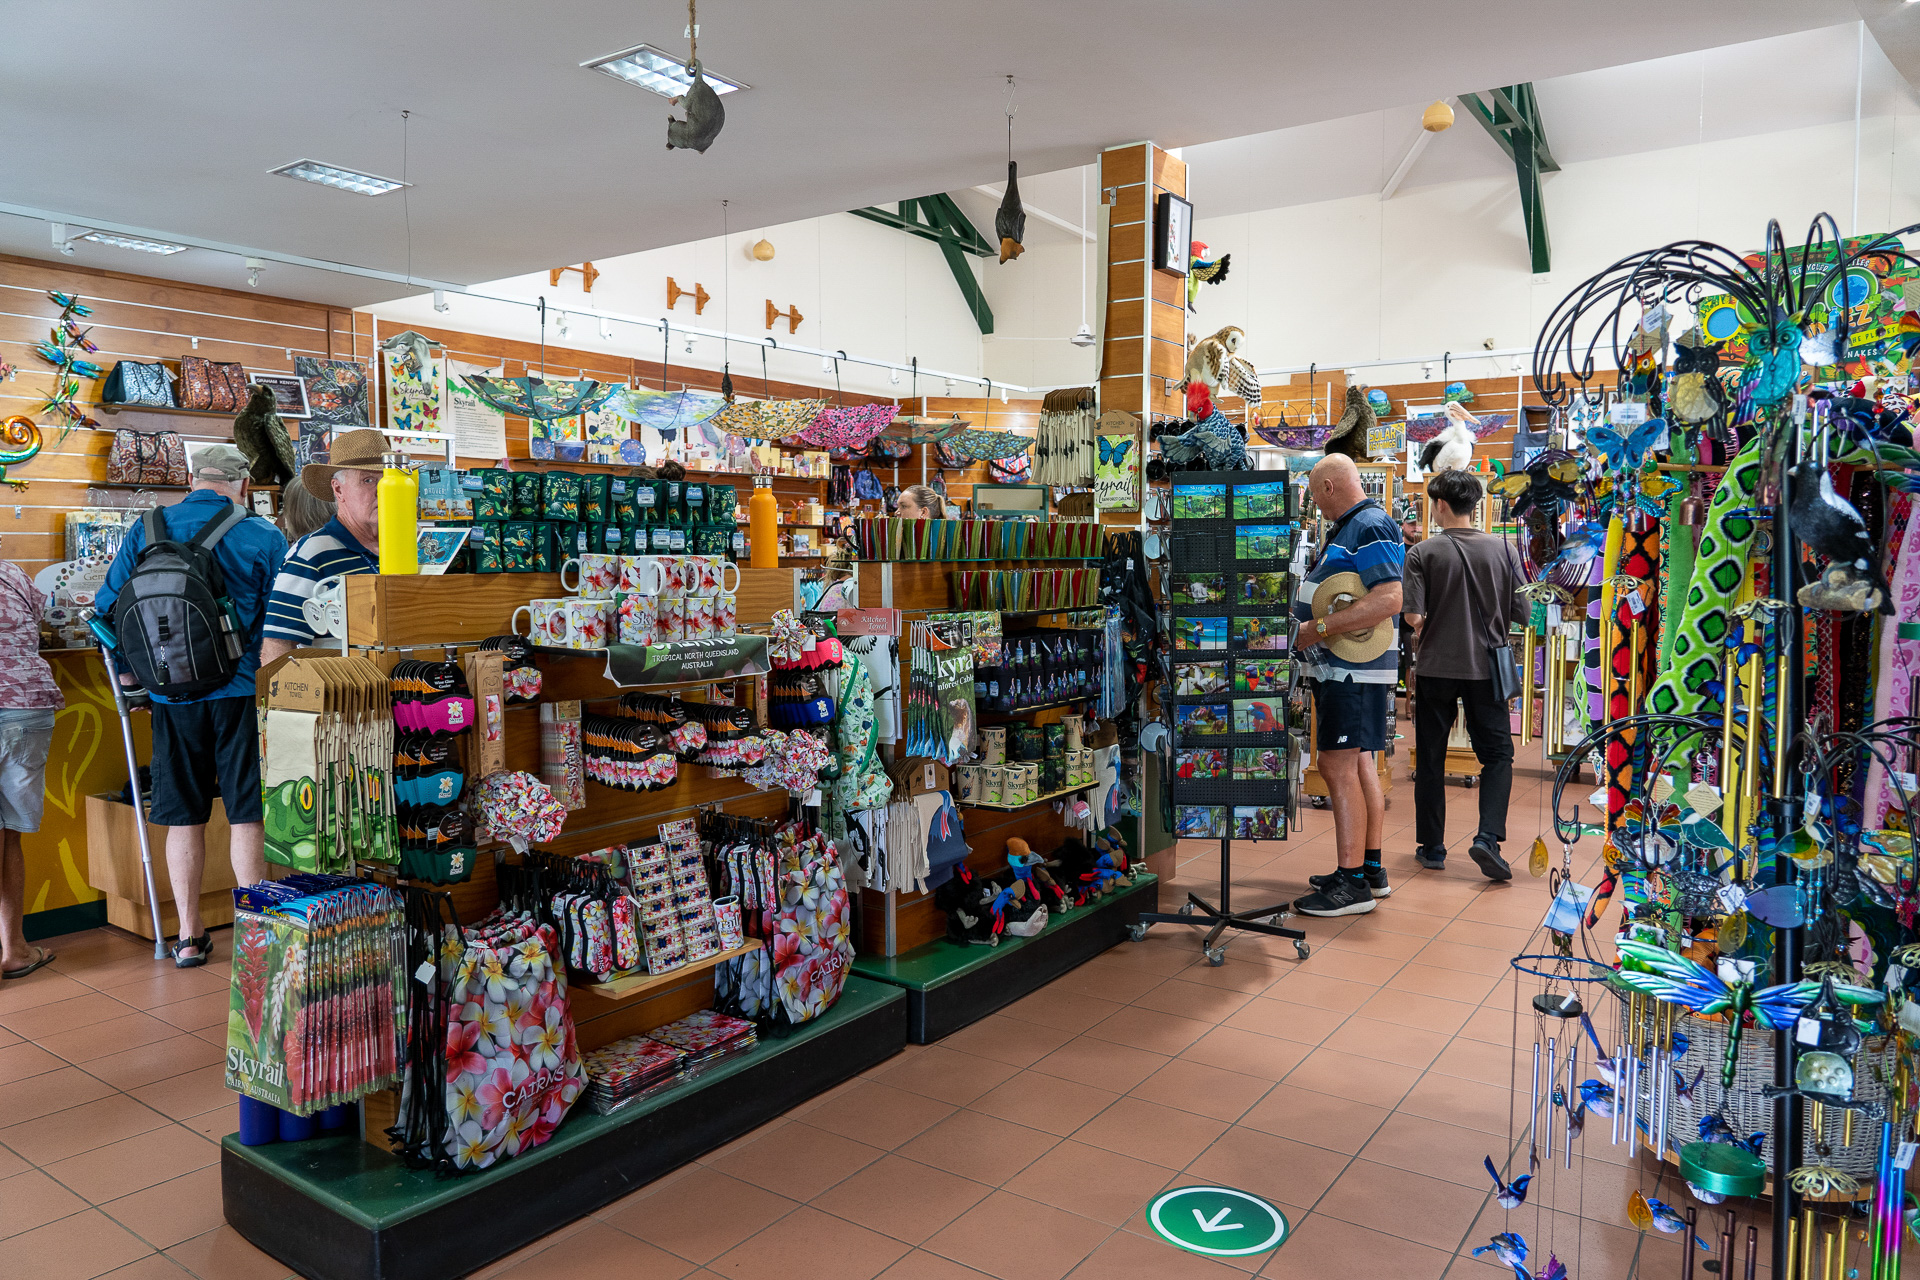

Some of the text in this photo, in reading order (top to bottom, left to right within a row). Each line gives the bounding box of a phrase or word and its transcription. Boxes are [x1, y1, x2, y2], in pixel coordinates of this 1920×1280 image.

[1865, 326, 1896, 340] PLET
[256, 377, 278, 385] GRAHAM
[454, 397, 476, 407] Skyrail
[1369, 427, 1396, 442] SOLAR
[861, 615, 888, 624] Kitchen
[868, 622, 888, 630] Towel
[652, 648, 739, 662] TROPICAL NORTH QUEENSLAND
[681, 660, 714, 669] AUSTRALIA
[284, 682, 309, 692] KITCHEN
[937, 679, 959, 690] nforest
[565, 743, 577, 787] Skyrail
[718, 914, 740, 928] rail
[227, 1046, 284, 1088] Skyrail
[226, 1076, 281, 1105] CAIRNS AUSTRALIA
[502, 1064, 565, 1108] CAIRNS
